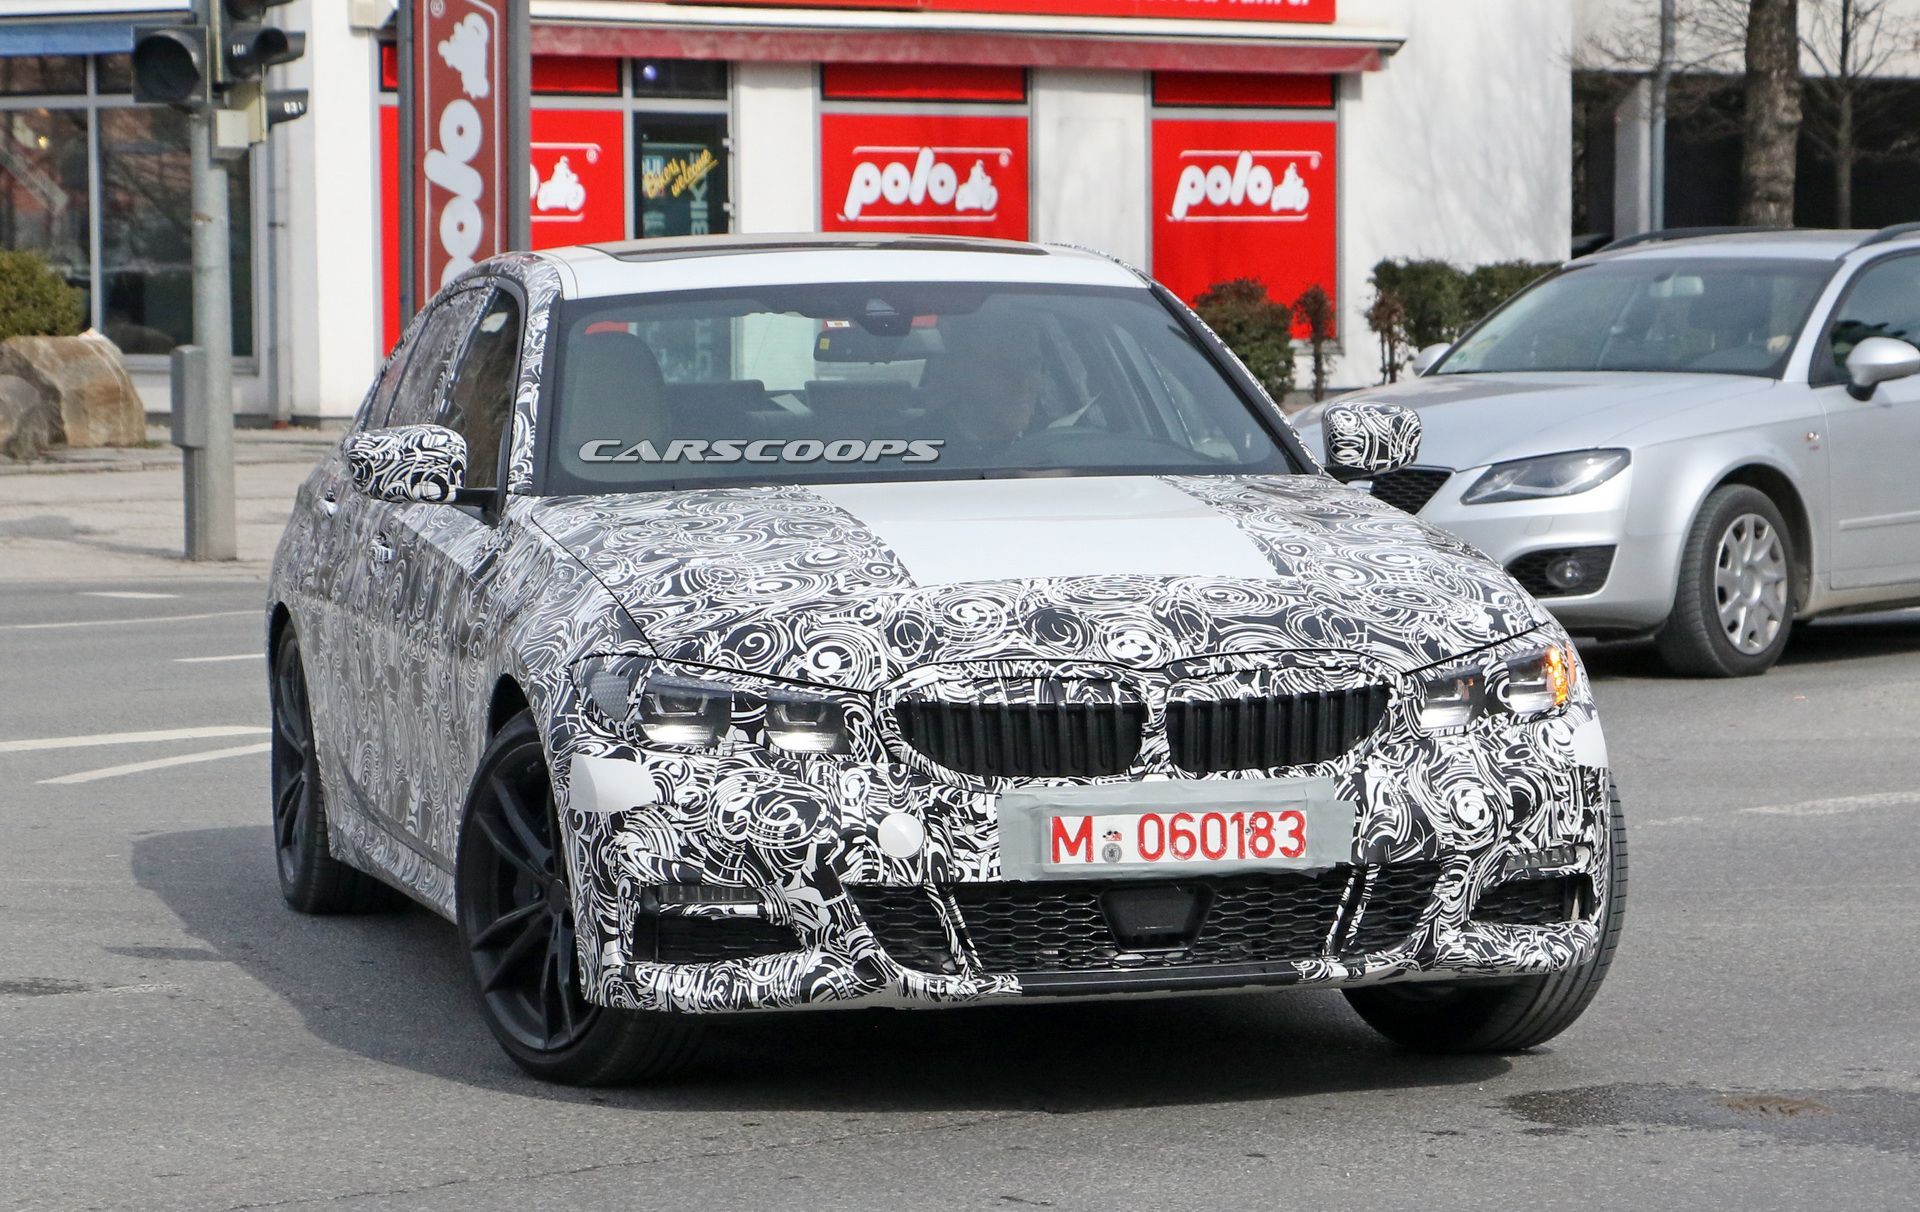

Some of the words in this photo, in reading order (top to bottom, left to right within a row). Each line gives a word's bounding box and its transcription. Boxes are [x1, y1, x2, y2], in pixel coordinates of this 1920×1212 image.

[844, 147, 957, 220] polo
[1172, 151, 1273, 220] polo
[1051, 815, 1094, 863] M
[1137, 810, 1306, 862] 060183
